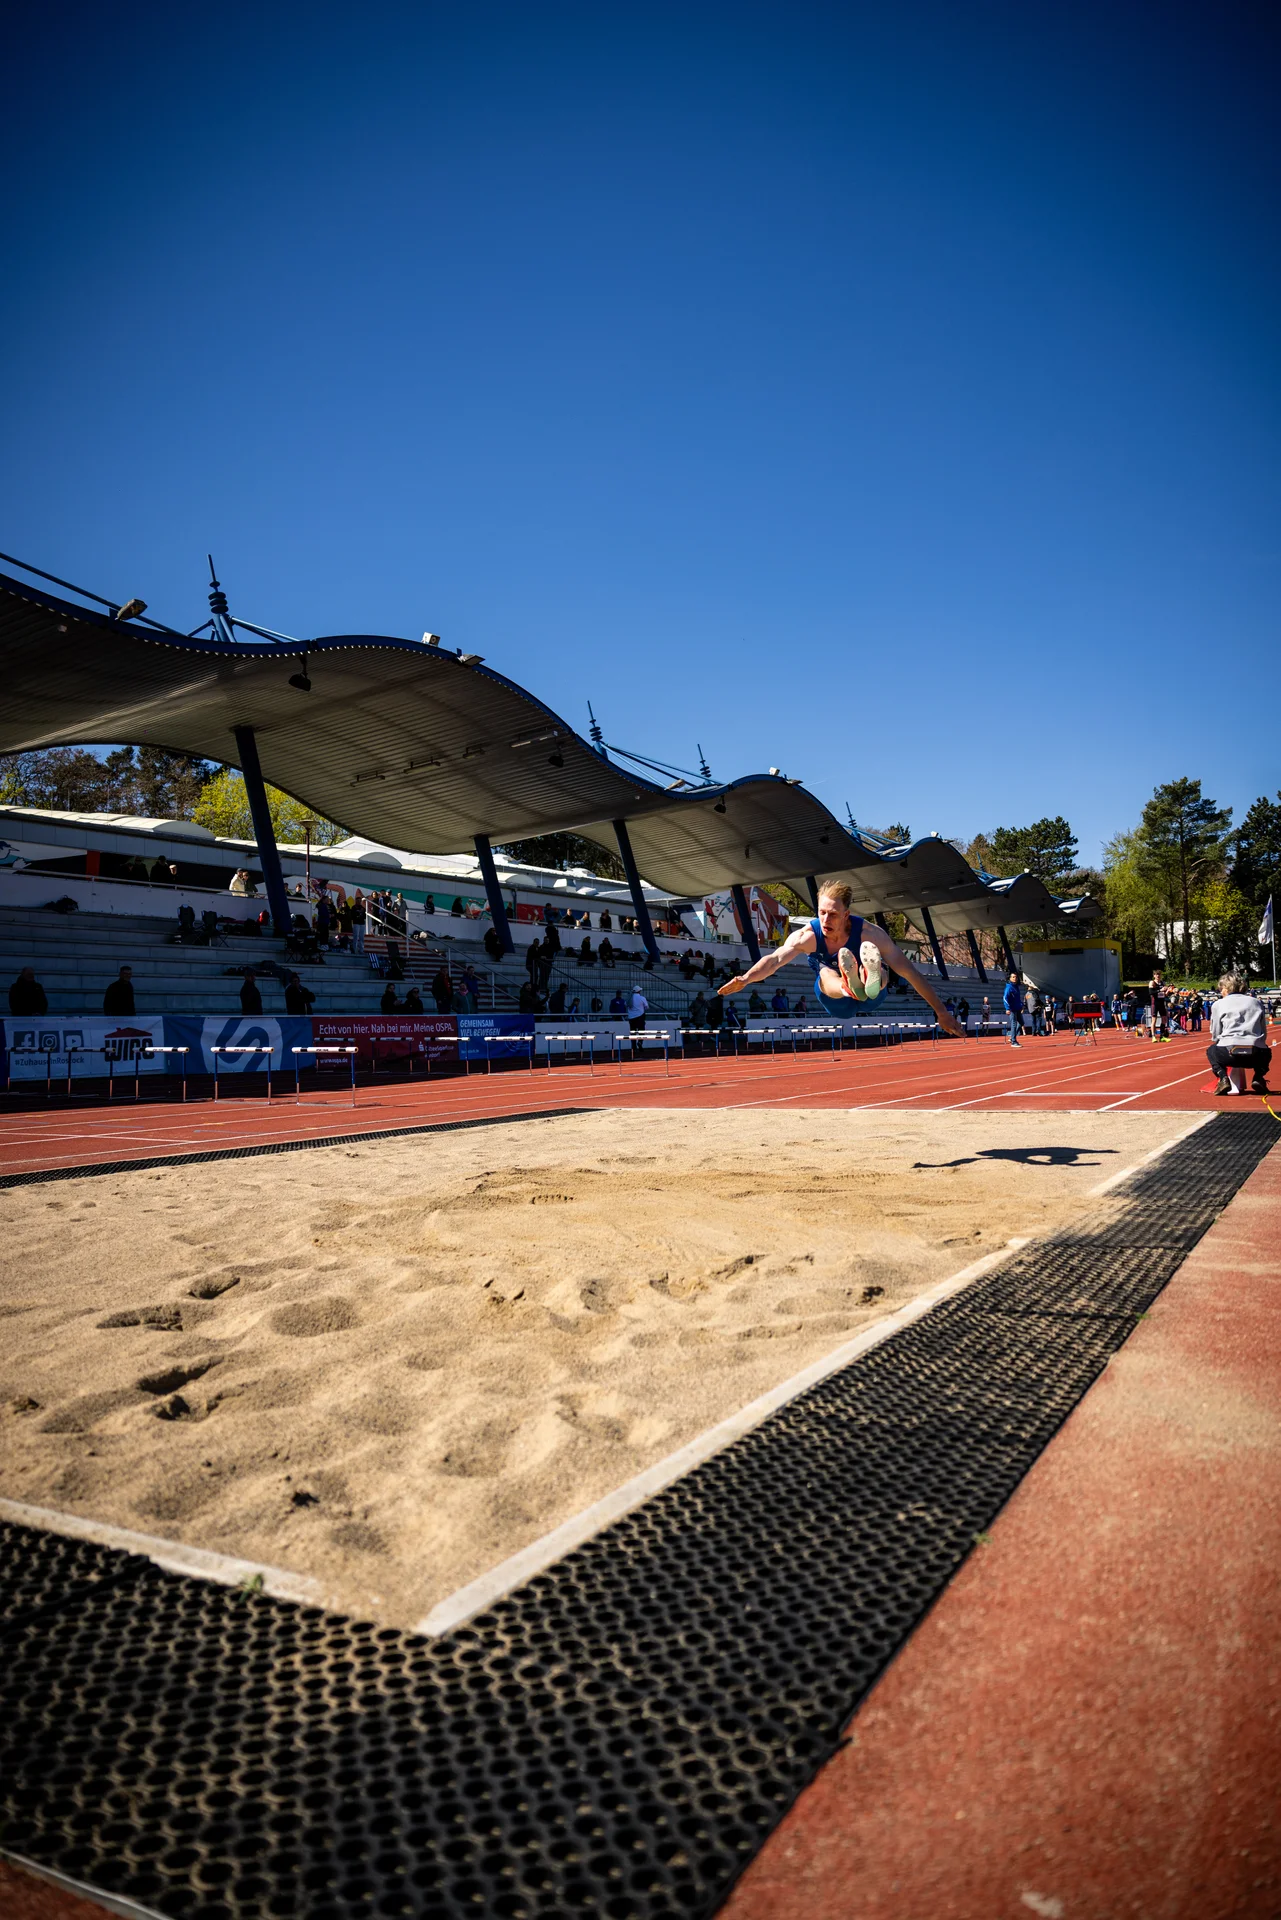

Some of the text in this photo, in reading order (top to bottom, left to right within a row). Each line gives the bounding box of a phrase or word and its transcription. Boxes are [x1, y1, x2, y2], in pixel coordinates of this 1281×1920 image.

[319, 1022, 455, 1035] Echt von hier. Nah bei mir. Meine OSPA.
[459, 1019, 495, 1028] GEMEINSAM
[460, 1027, 501, 1037] VIEL BEWEGEN
